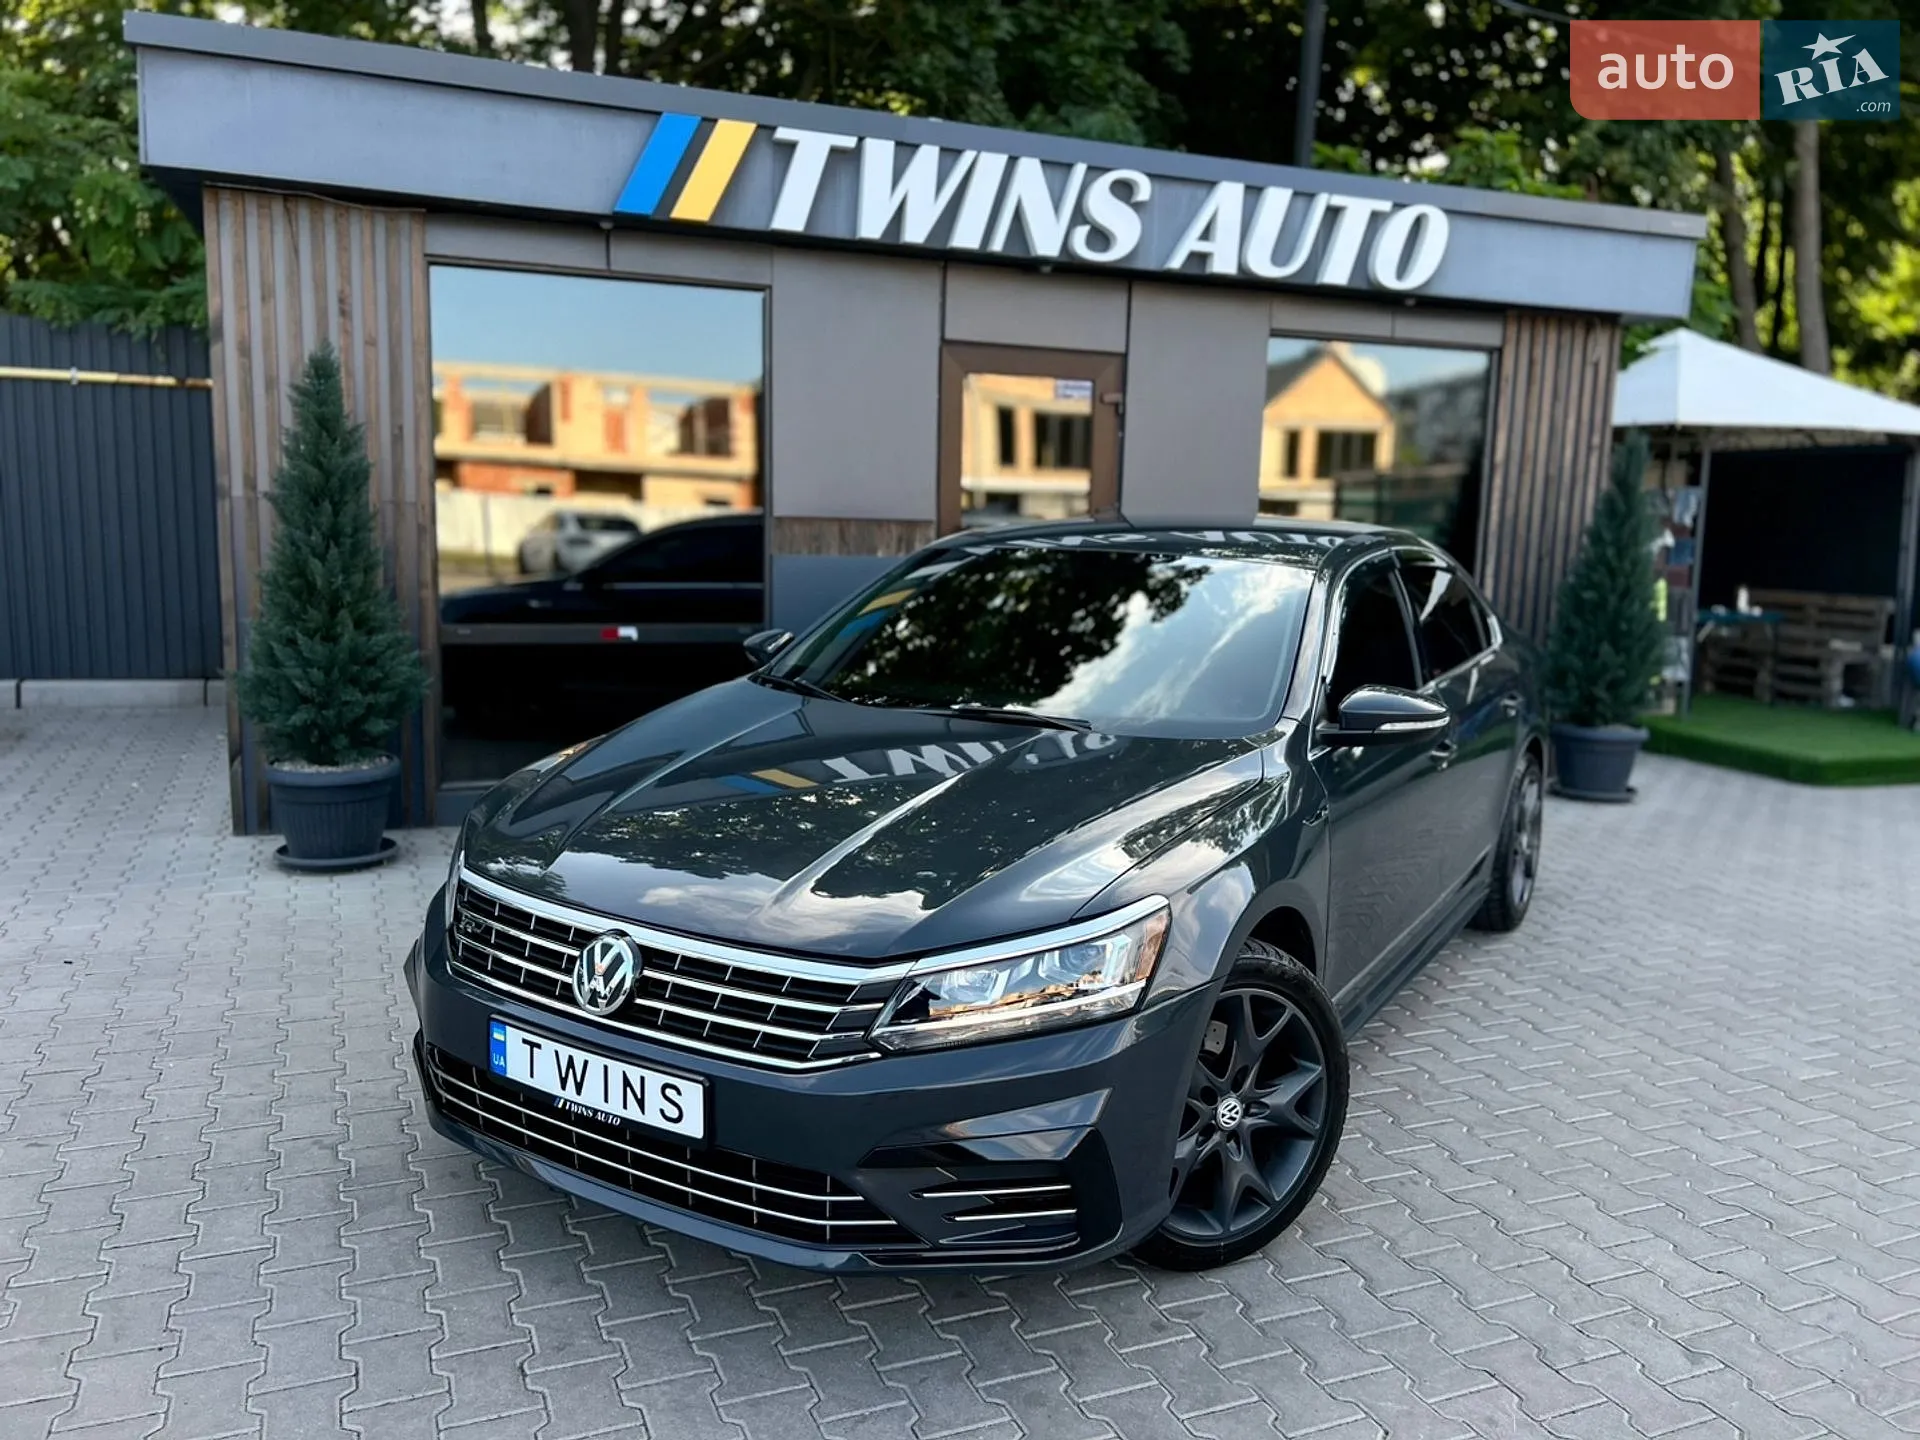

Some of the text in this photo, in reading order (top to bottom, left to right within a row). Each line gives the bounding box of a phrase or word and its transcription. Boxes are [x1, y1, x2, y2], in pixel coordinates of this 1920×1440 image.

[770, 127, 1451, 291] TWINS AUTO
[492, 1052, 506, 1068] UA
[565, 1101, 622, 1126] TWINS AUTO
